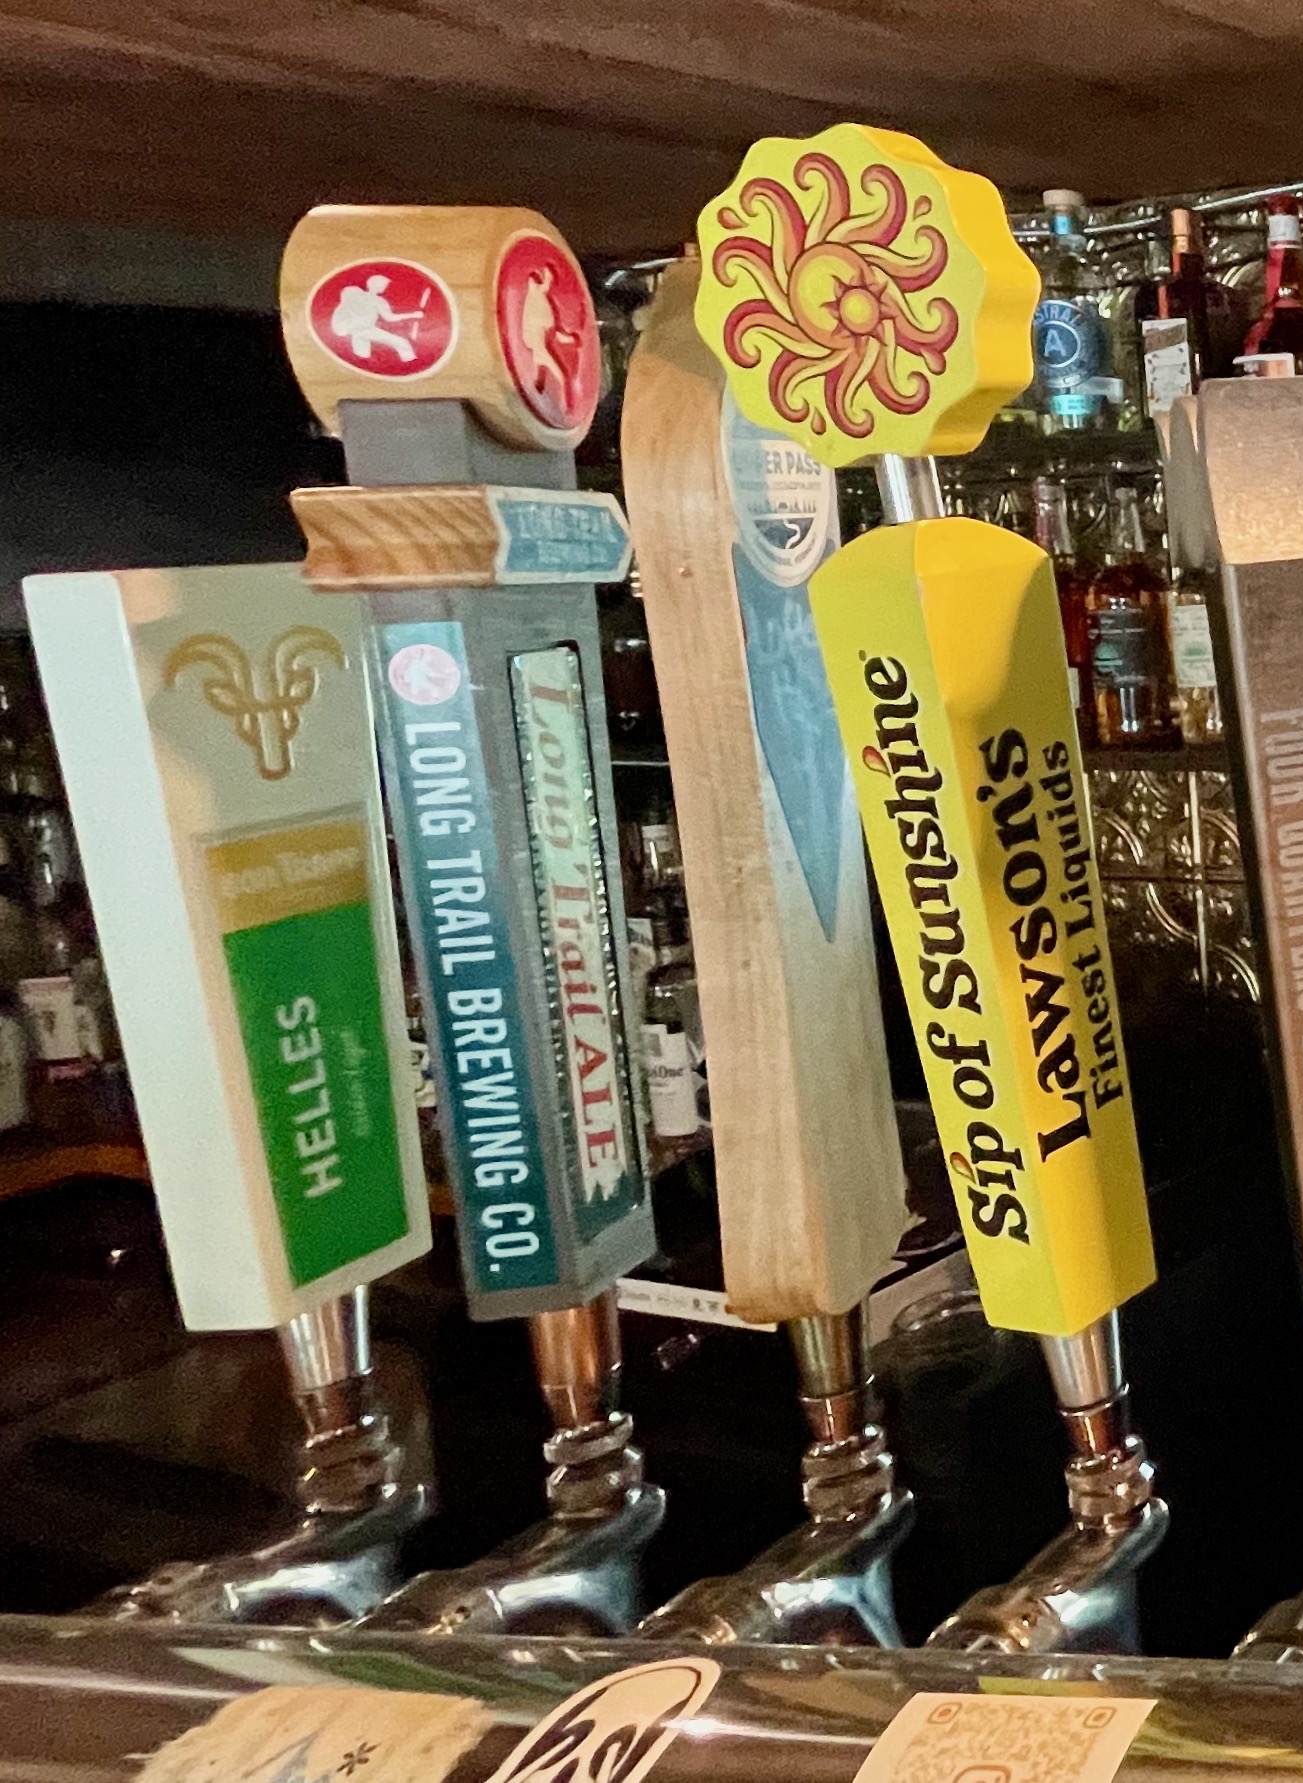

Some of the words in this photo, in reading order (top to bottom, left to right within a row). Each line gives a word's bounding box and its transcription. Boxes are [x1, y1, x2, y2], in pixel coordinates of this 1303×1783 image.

[405, 721, 474, 837] LONG
[529, 684, 575, 852] Long
[862, 655, 984, 1016] Sunshine
[1042, 740, 1096, 941] Liquids
[426, 849, 498, 977] TRAIL
[551, 862, 608, 1024] Trail
[976, 728, 1093, 1163] Lawson's
[276, 995, 344, 1198] HELLES
[447, 986, 531, 1188] BREWING
[572, 1036, 621, 1170] ALE
[926, 1020, 996, 1109] of
[1072, 943, 1126, 1110] Finest
[480, 1204, 541, 1274] CO.
[949, 1121, 1032, 1246] Sip
